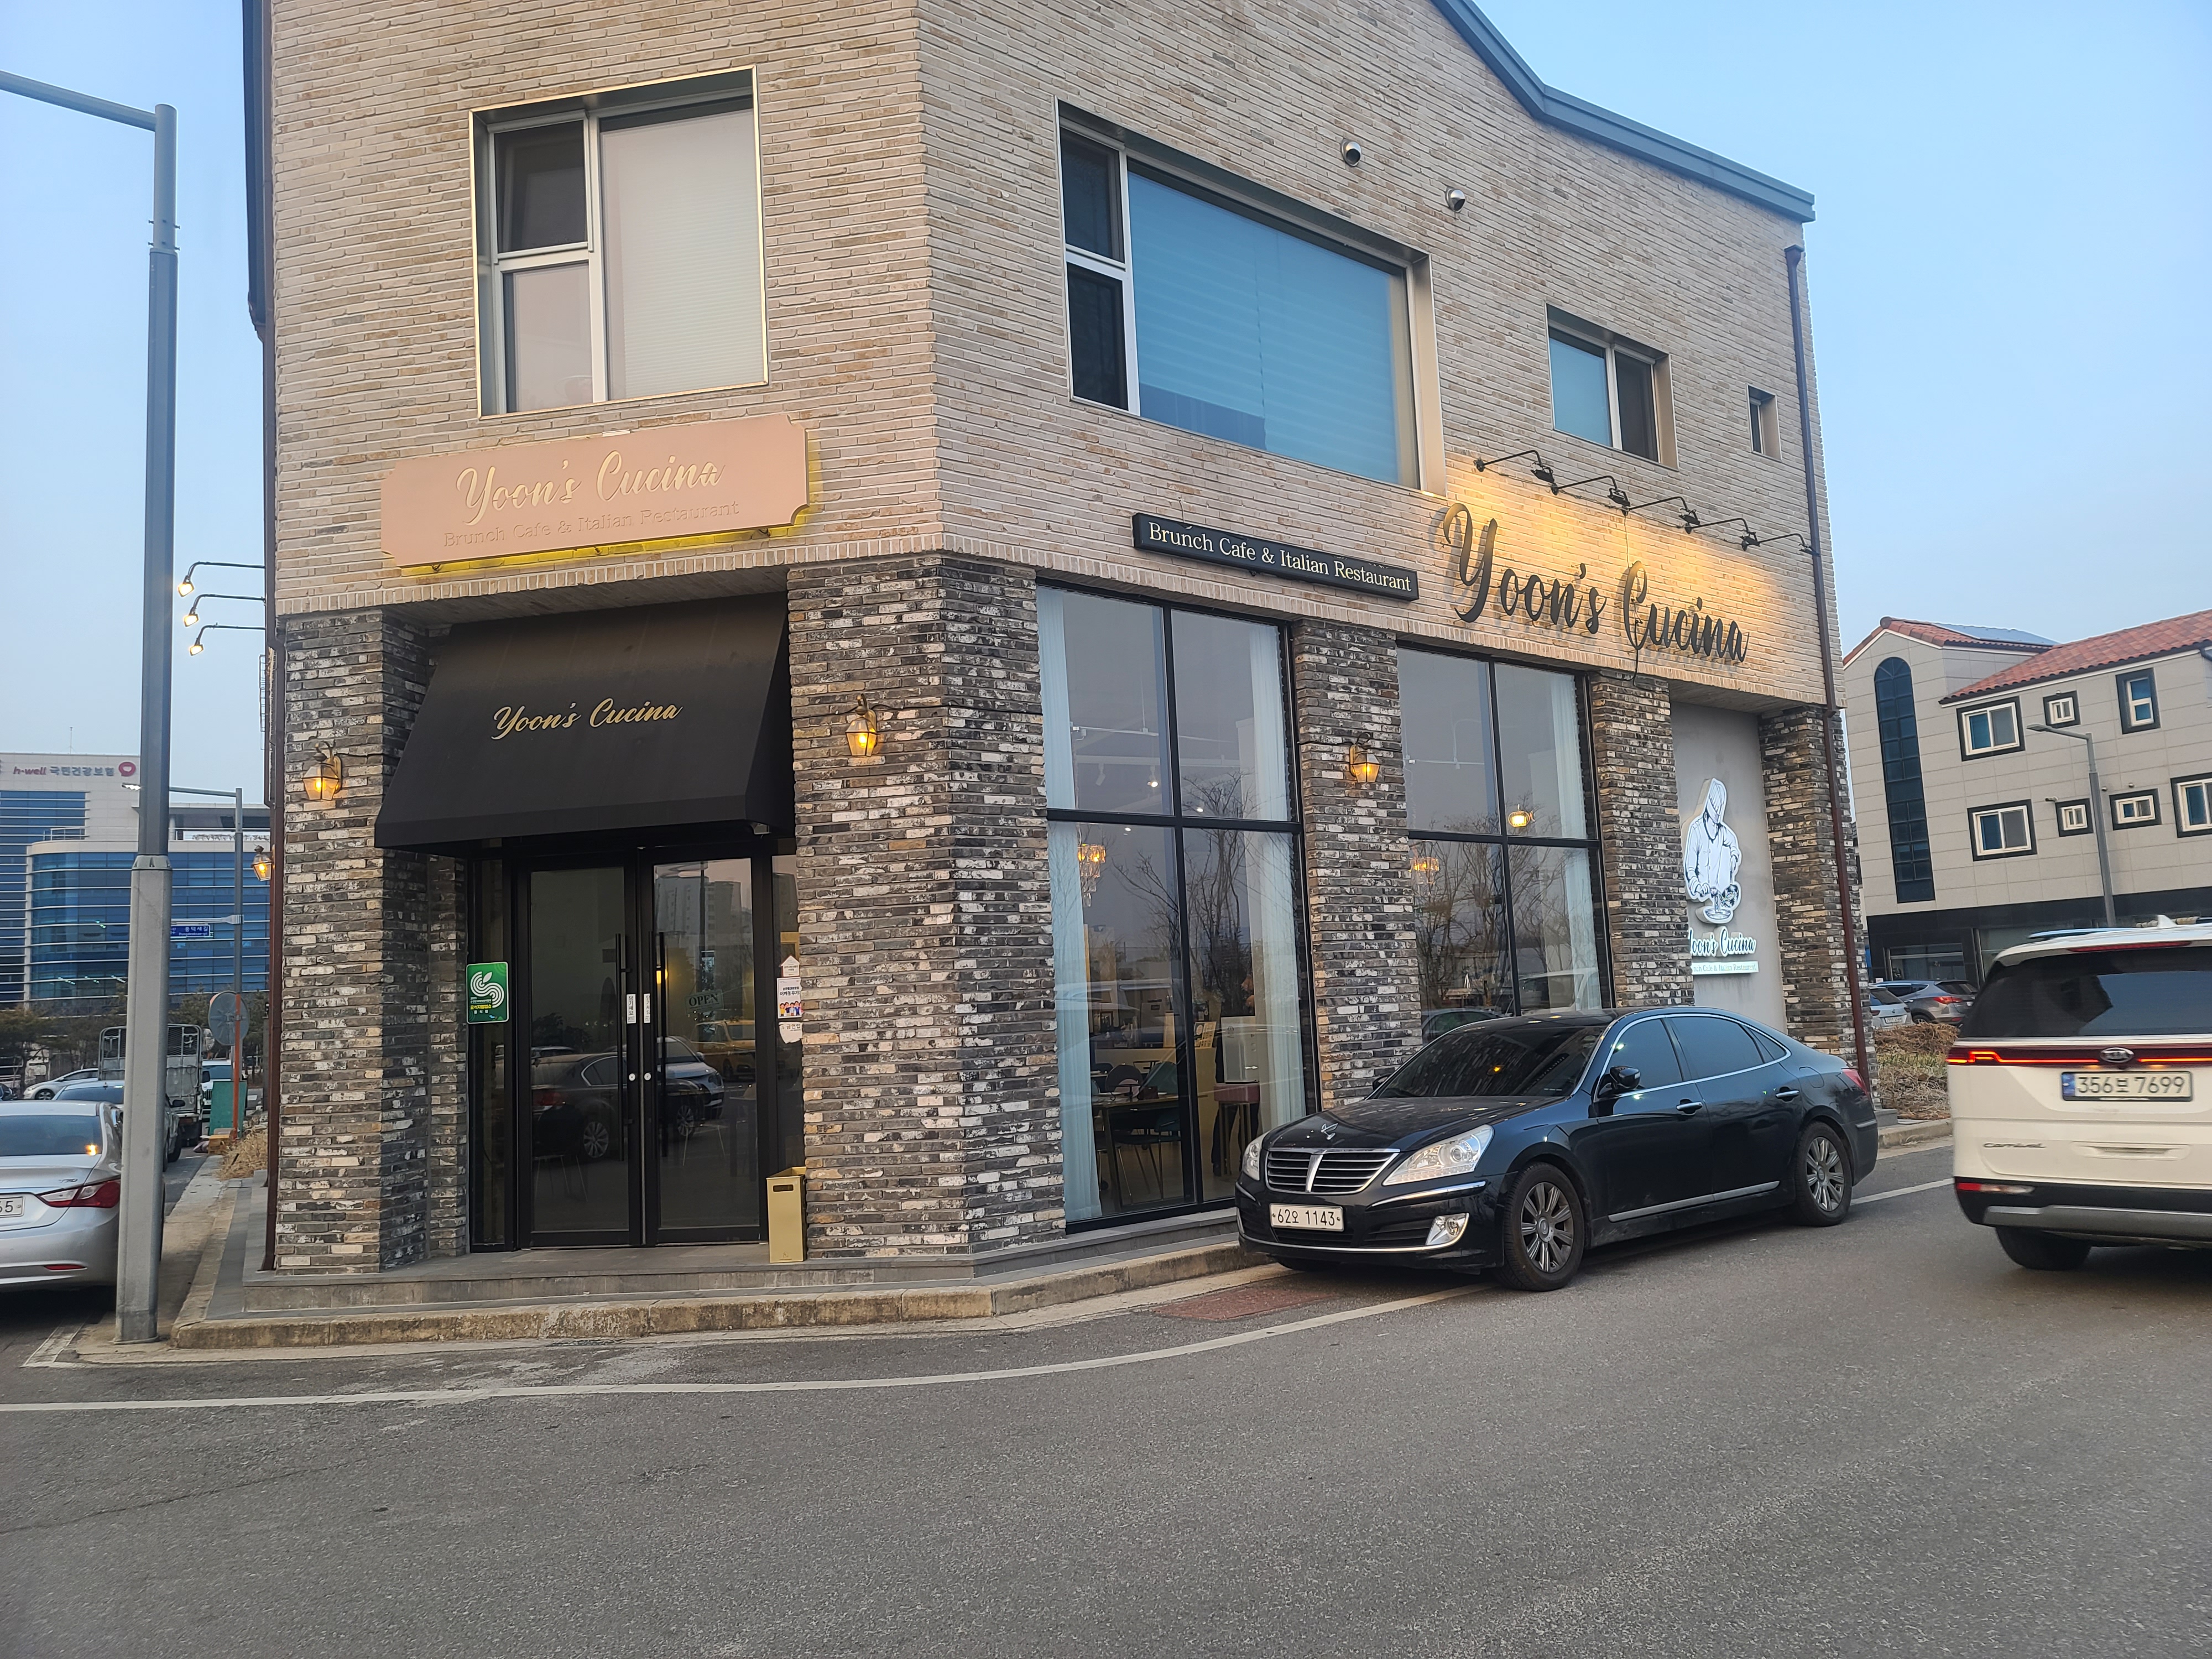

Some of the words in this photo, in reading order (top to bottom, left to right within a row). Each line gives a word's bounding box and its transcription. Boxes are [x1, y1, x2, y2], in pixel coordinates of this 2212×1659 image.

[456, 460, 582, 526] Yoon's
[597, 450, 725, 502] Cucina
[444, 527, 506, 547] Brunch
[513, 523, 551, 539] Cafe
[557, 520, 572, 534] &
[578, 514, 633, 532] Italian
[640, 501, 740, 525] Restaurant
[1148, 522, 1214, 552] Brunch
[1219, 538, 1256, 561] Cafe
[1261, 547, 1275, 564] &
[1280, 549, 1329, 575] Italian
[1334, 561, 1412, 592] Restaurant
[1443, 502, 1607, 634] Yoon's
[1623, 560, 1750, 663] Cucina
[491, 702, 582, 740] Yoon's
[589, 698, 684, 728] Cucina
[1720, 928, 1756, 954] Cucina
[689, 993, 718, 1006] OPEN
[2134, 1076, 2184, 1093] 7699
[1277, 1208, 1299, 1223] 62오
[1306, 1210, 1335, 1226] 1143
